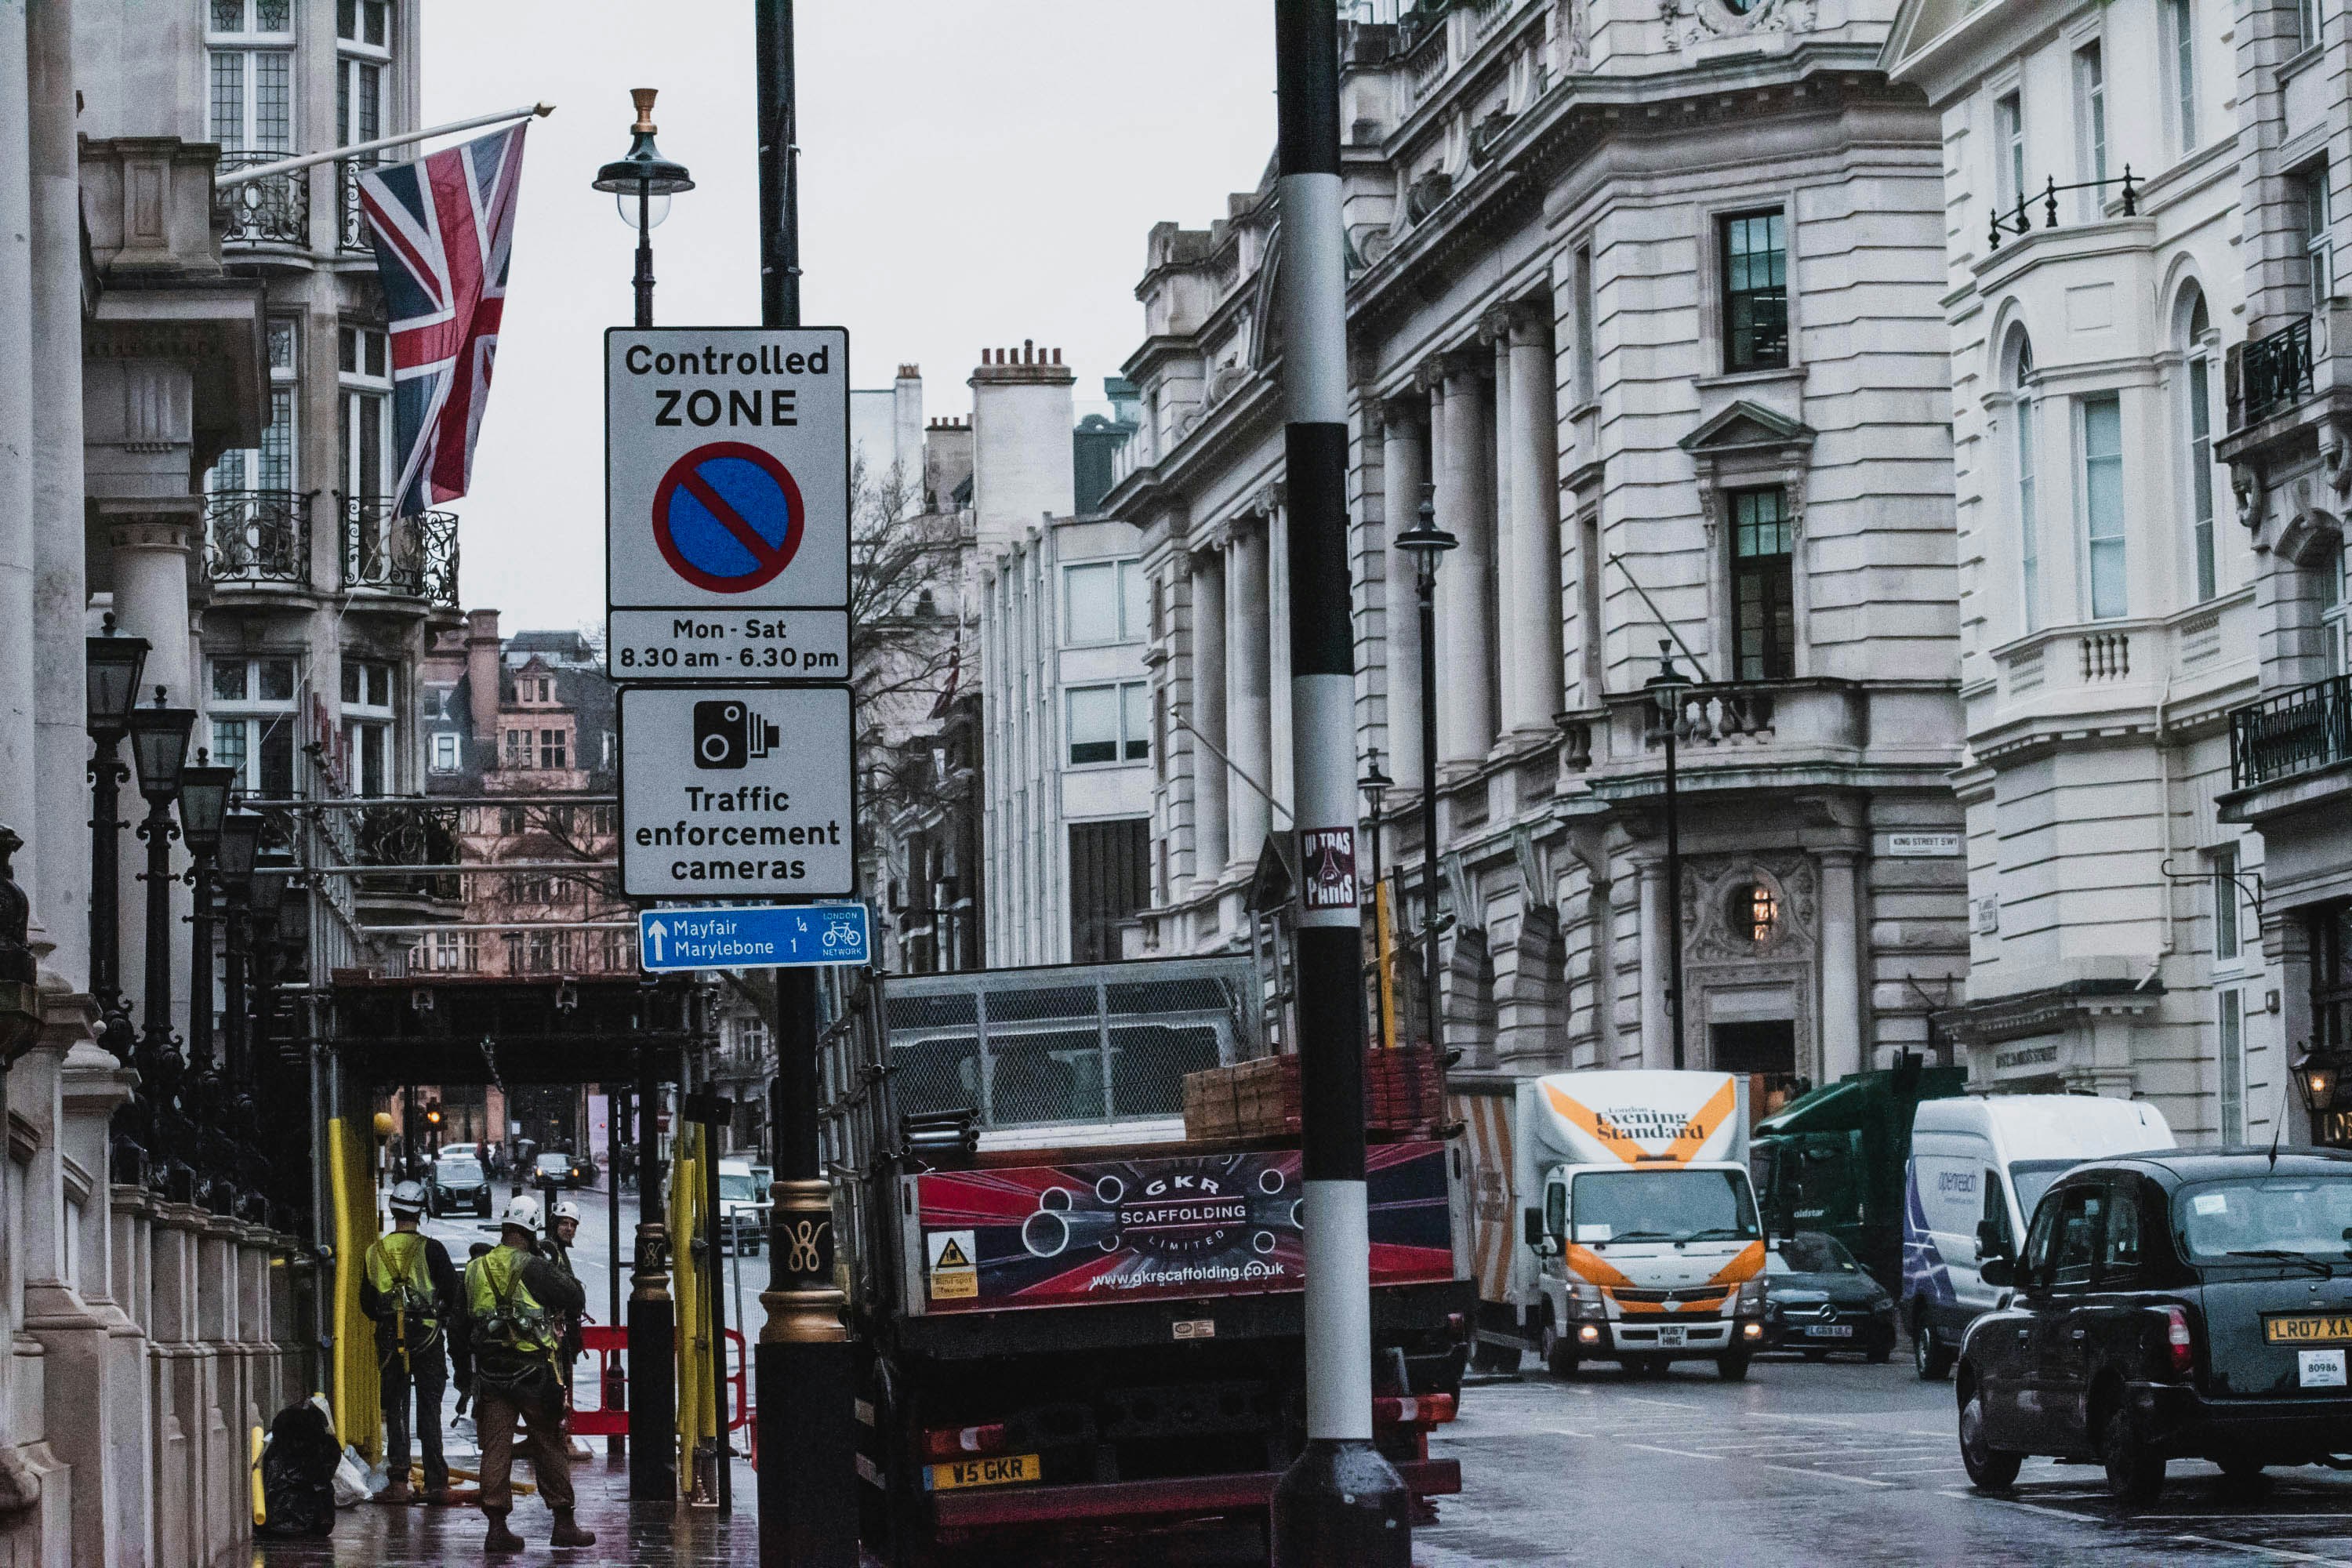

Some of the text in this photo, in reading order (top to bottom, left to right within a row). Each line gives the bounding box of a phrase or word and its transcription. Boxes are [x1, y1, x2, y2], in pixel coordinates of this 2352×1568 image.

[626, 345, 829, 376] Controlled
[655, 389, 798, 426] ZONE
[673, 619, 728, 639] Mon
[744, 619, 787, 639] Sat
[620, 648, 678, 668] 8.30
[684, 652, 720, 667] am
[739, 648, 797, 667] 6.30
[803, 651, 840, 670] pm
[684, 786, 790, 812] Traffic
[635, 820, 841, 846] enforcement
[1912, 837, 1939, 846] STREET
[671, 859, 806, 880] cameras
[822, 911, 858, 920] LONDON
[673, 919, 738, 939] Mayfair
[674, 937, 797, 960] Marylebone 1
[822, 947, 862, 956] NETWORK
[1595, 1110, 1690, 1127] Evening
[1596, 1124, 1704, 1141] Standard
[1145, 1176, 1220, 1196] GKR
[1121, 1205, 1247, 1225] SCAFFOLDING
[1793, 1208, 1824, 1218] oldstar
[1149, 1229, 1225, 1251] LIMITED
[956, 1276, 972, 1285] spot
[1091, 1262, 1286, 1287] www.gkrscaffolding.co.uk
[2275, 1319, 2352, 1338] LR07 XA
[2308, 1363, 2338, 1373] 80986
[953, 1458, 1024, 1483] W5 GKR
